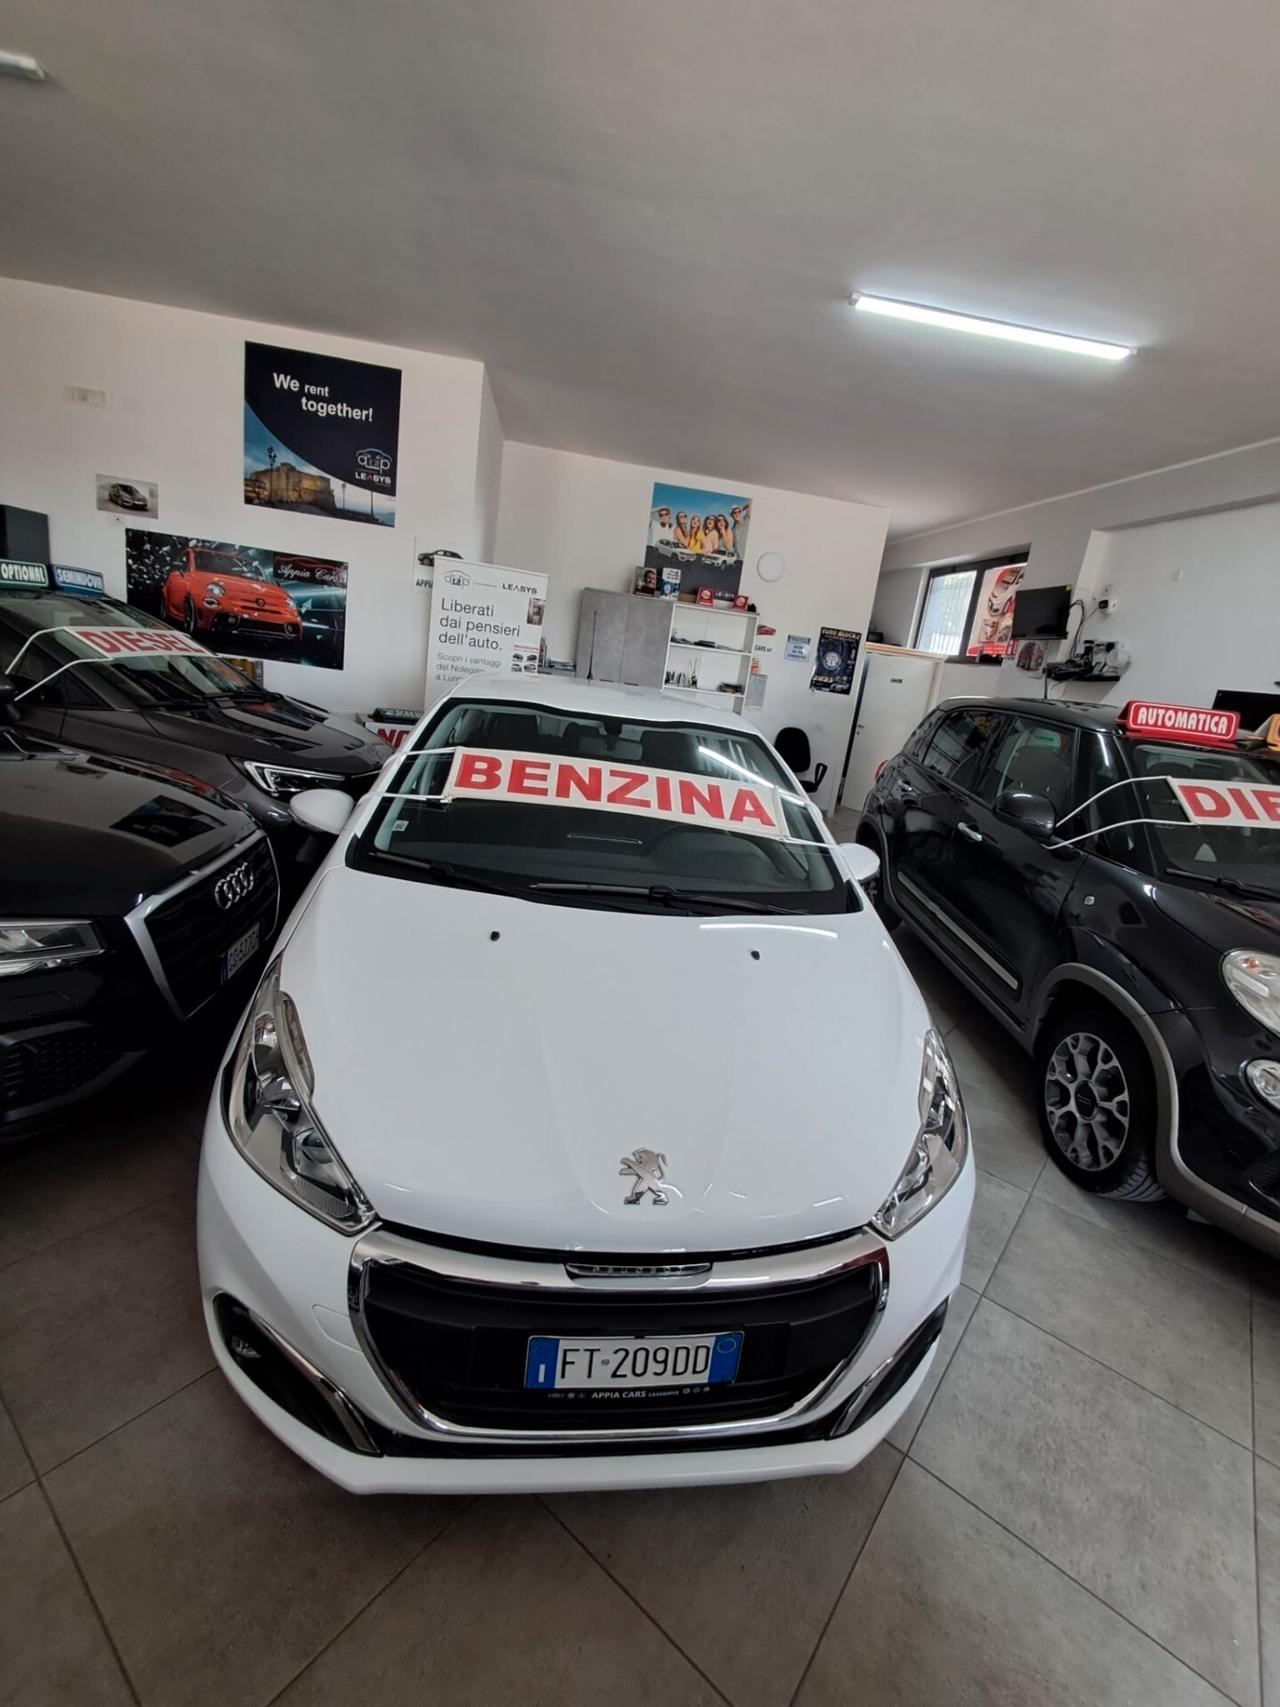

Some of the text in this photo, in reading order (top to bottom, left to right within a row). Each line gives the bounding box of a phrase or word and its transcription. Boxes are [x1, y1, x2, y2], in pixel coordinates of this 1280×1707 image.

[273, 372, 329, 397] We rent
[301, 396, 373, 422] together!
[355, 471, 391, 484] LEASYS
[1, 563, 46, 583] OPTIONAL
[502, 582, 538, 595] LEASYS
[441, 597, 495, 617] Liberati
[439, 616, 520, 638] dai pensieri
[77, 630, 208, 653] DIESEL
[438, 632, 503, 651] dell'auto.
[437, 652, 464, 663] Scopri
[1137, 706, 1228, 734] AUTOMATICA
[454, 753, 776, 827] BENZINA
[591, 1389, 620, 1399] APPIA
[622, 1390, 647, 1398] CARS
